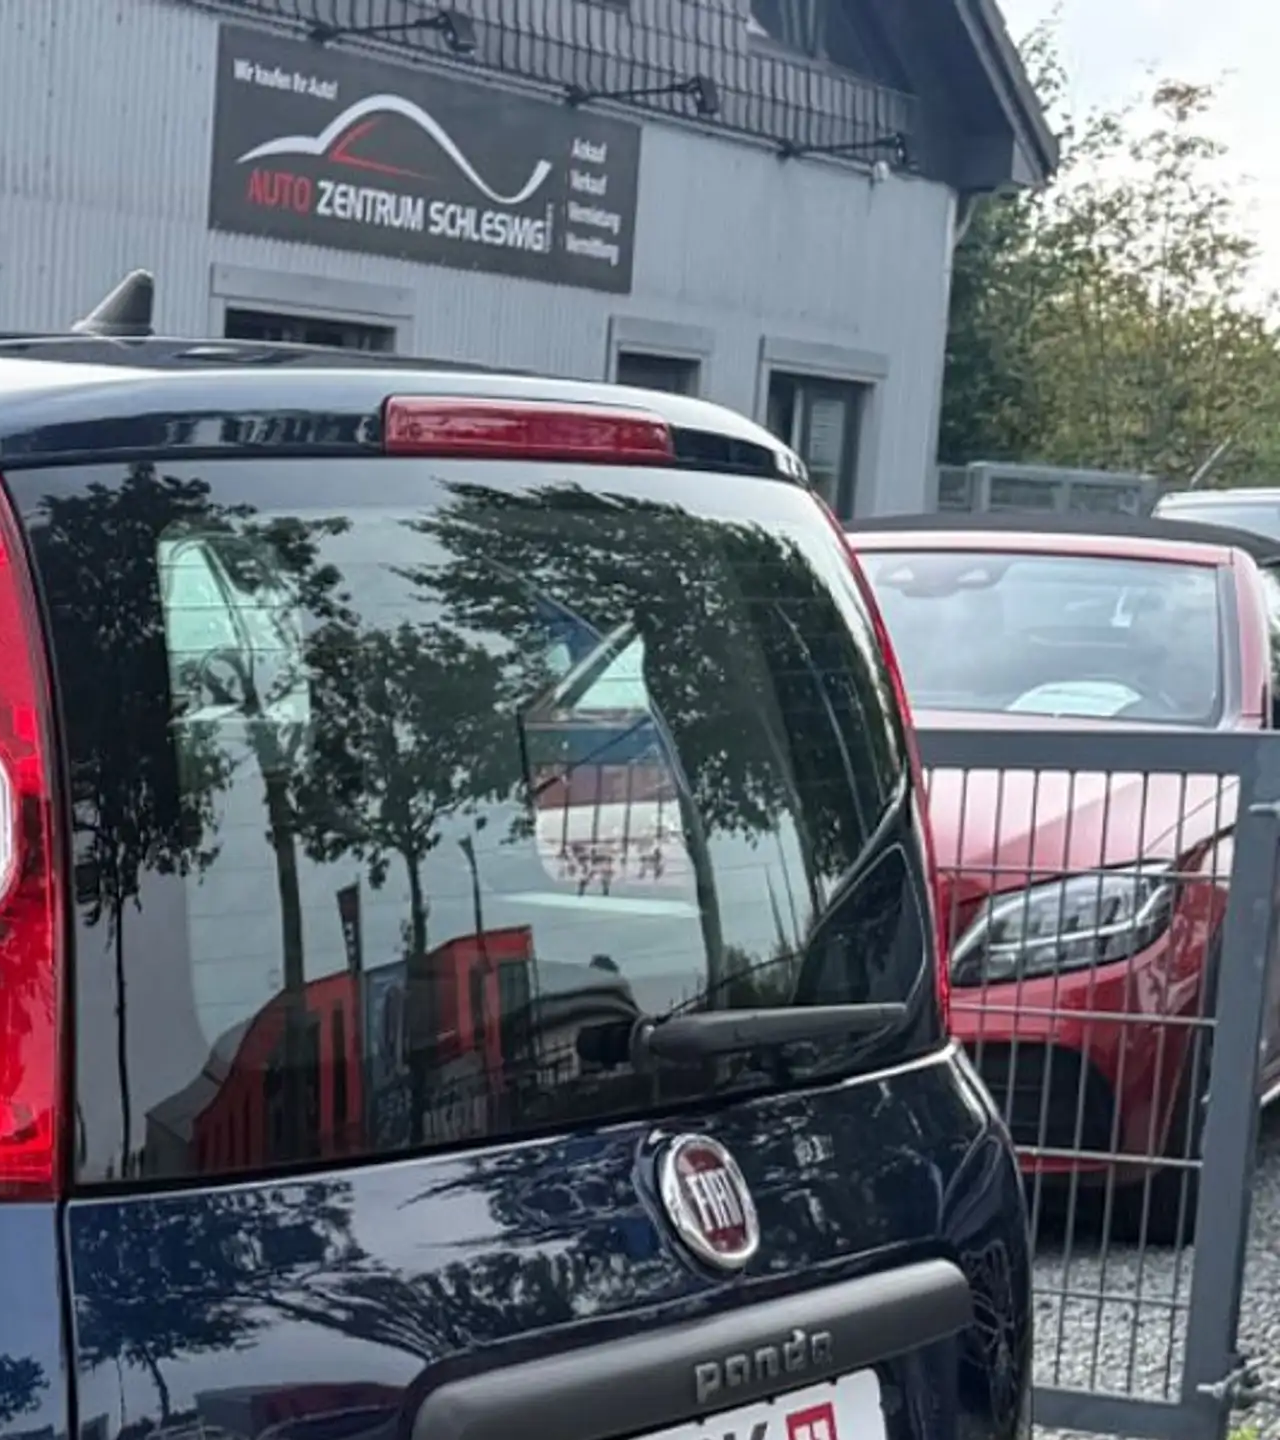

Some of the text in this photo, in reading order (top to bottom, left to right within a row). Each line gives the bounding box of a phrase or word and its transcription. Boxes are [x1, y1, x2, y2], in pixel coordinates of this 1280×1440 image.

[247, 166, 312, 216] AUTO
[316, 179, 424, 232] ZENTRUM
[428, 200, 545, 251] SCHLESWIG
[685, 1167, 744, 1232] FIAT
[694, 1329, 833, 1402] panda
